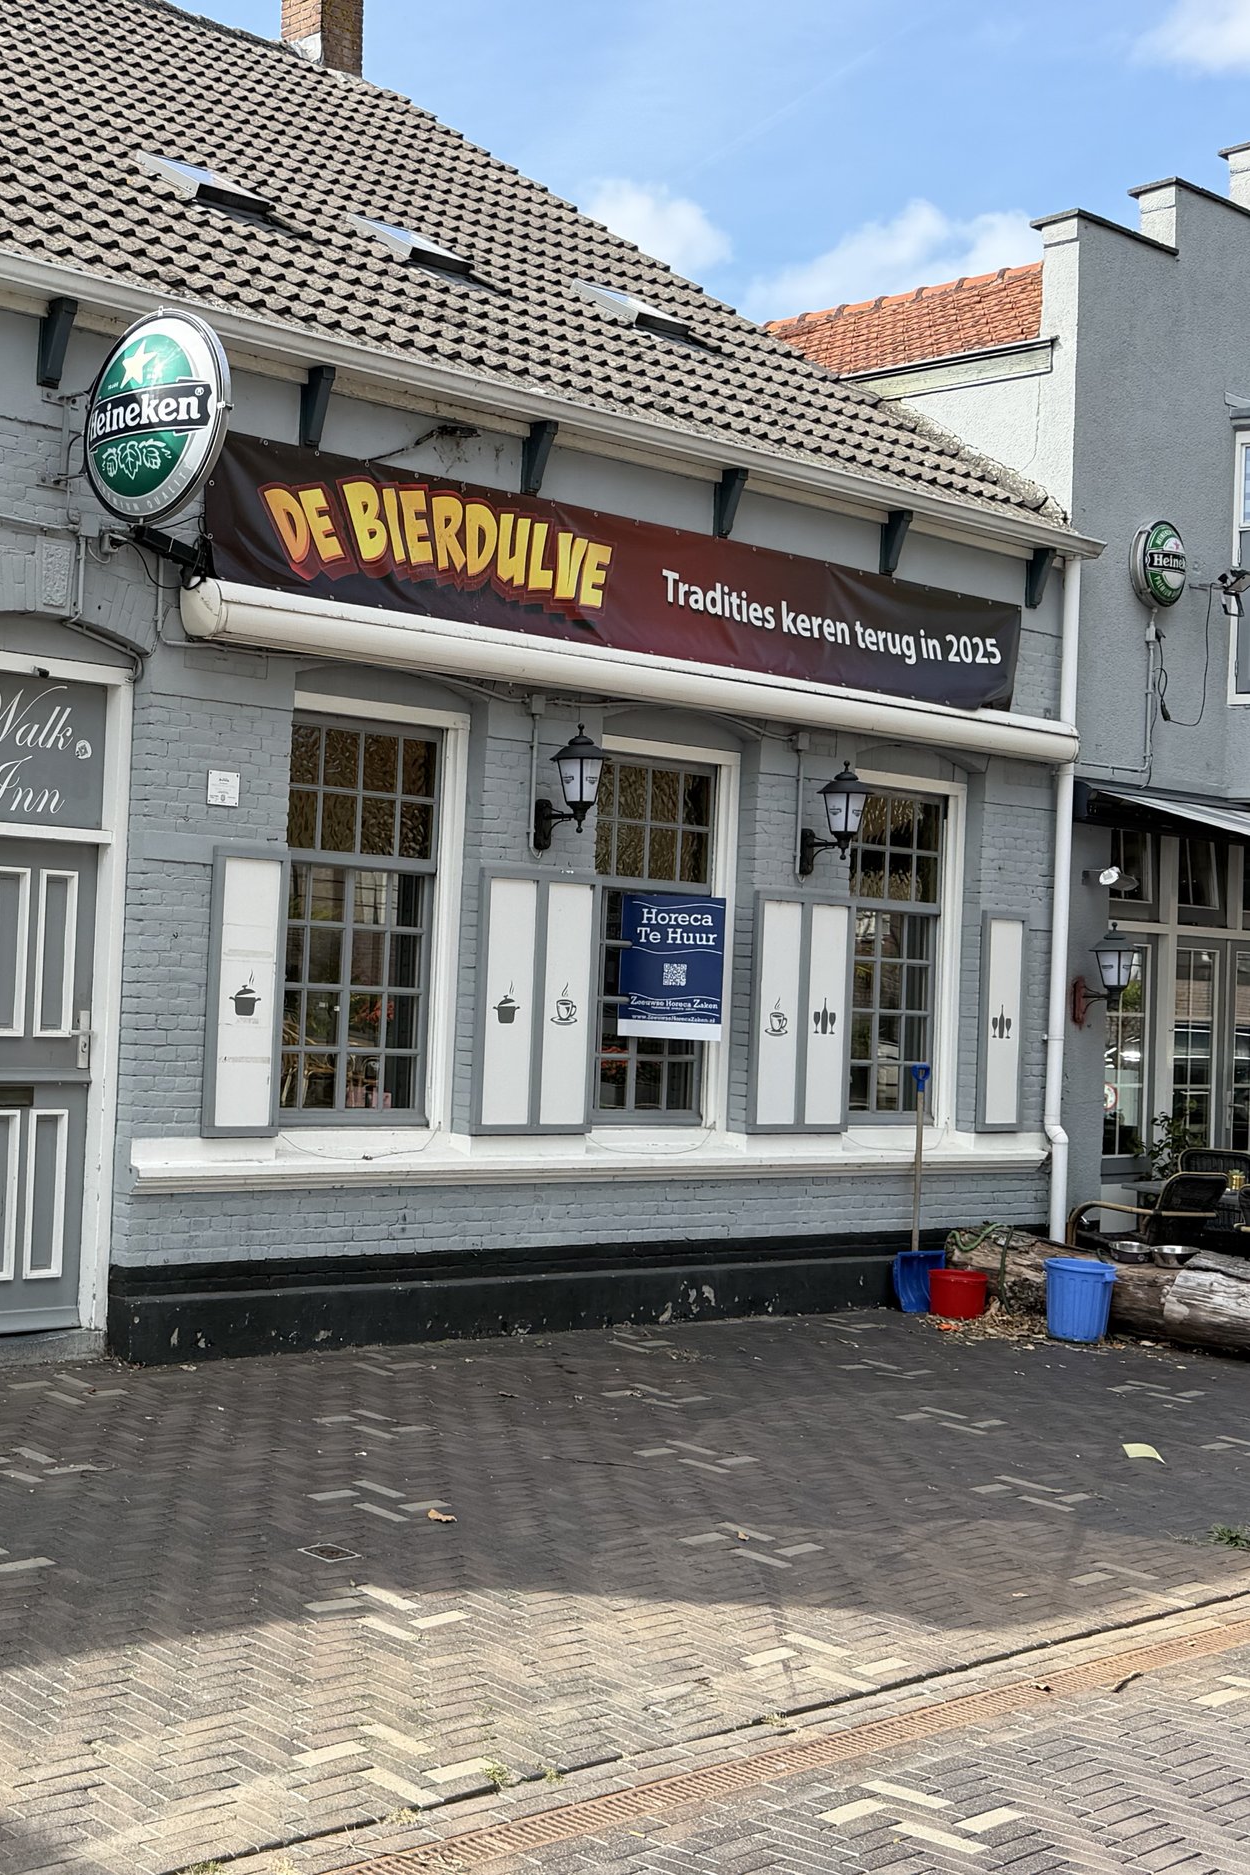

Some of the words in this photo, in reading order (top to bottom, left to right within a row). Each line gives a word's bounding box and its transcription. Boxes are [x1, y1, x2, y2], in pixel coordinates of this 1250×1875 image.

[90, 393, 201, 440] Heineken
[263, 487, 347, 565] DE
[342, 480, 613, 609] BIERDULVE
[1153, 554, 1186, 569] Heine
[662, 568, 776, 630] Tradities
[780, 600, 852, 646] keren
[854, 620, 917, 665] terug
[918, 629, 943, 661] in
[945, 633, 1002, 665] 2025
[641, 908, 714, 926] Horeca
[637, 927, 661, 943] Te
[666, 928, 718, 946] Huur
